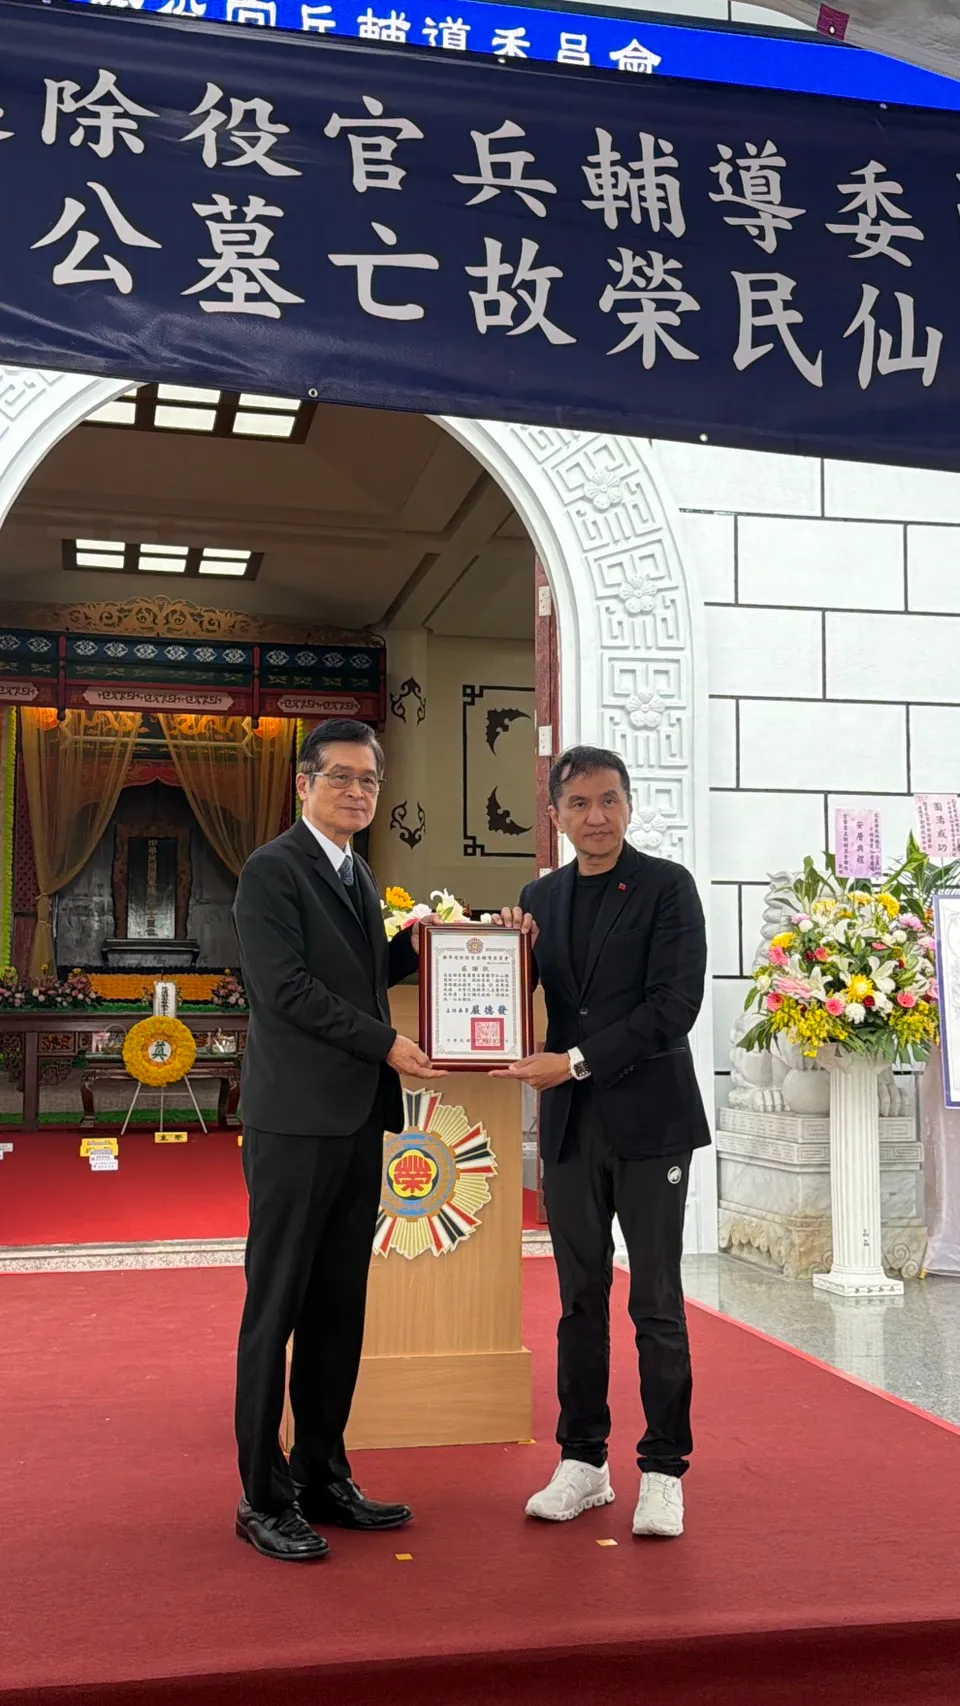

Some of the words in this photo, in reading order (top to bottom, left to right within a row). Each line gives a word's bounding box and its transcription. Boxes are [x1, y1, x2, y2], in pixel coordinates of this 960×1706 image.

[0, 69, 960, 267] 除役官兵輔導委
[30, 181, 943, 390] 公墓亡故榮民仙
